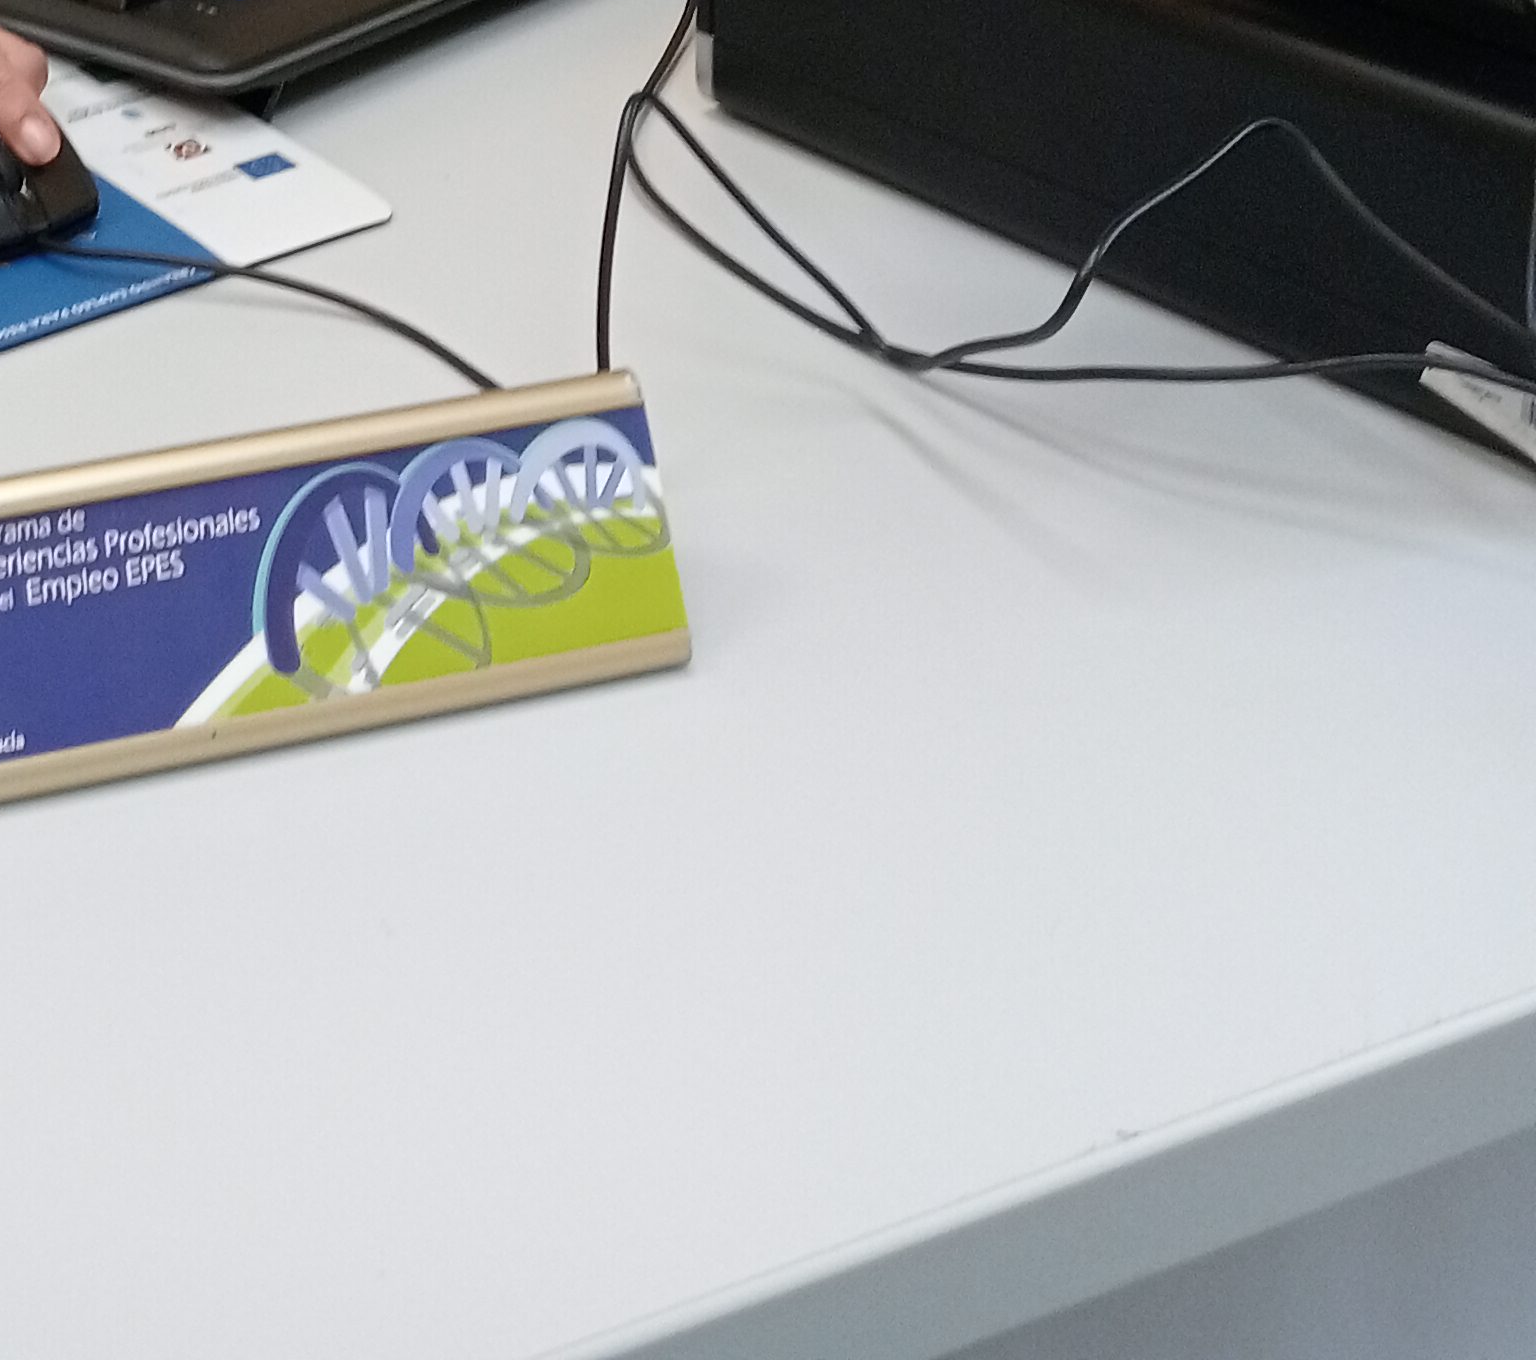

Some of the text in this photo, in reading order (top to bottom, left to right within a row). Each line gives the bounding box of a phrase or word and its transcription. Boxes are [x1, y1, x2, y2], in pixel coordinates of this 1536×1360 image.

[57, 507, 86, 535] de
[104, 504, 262, 555] Profesionales
[26, 570, 119, 610] Empleo
[126, 549, 185, 588] EPES
